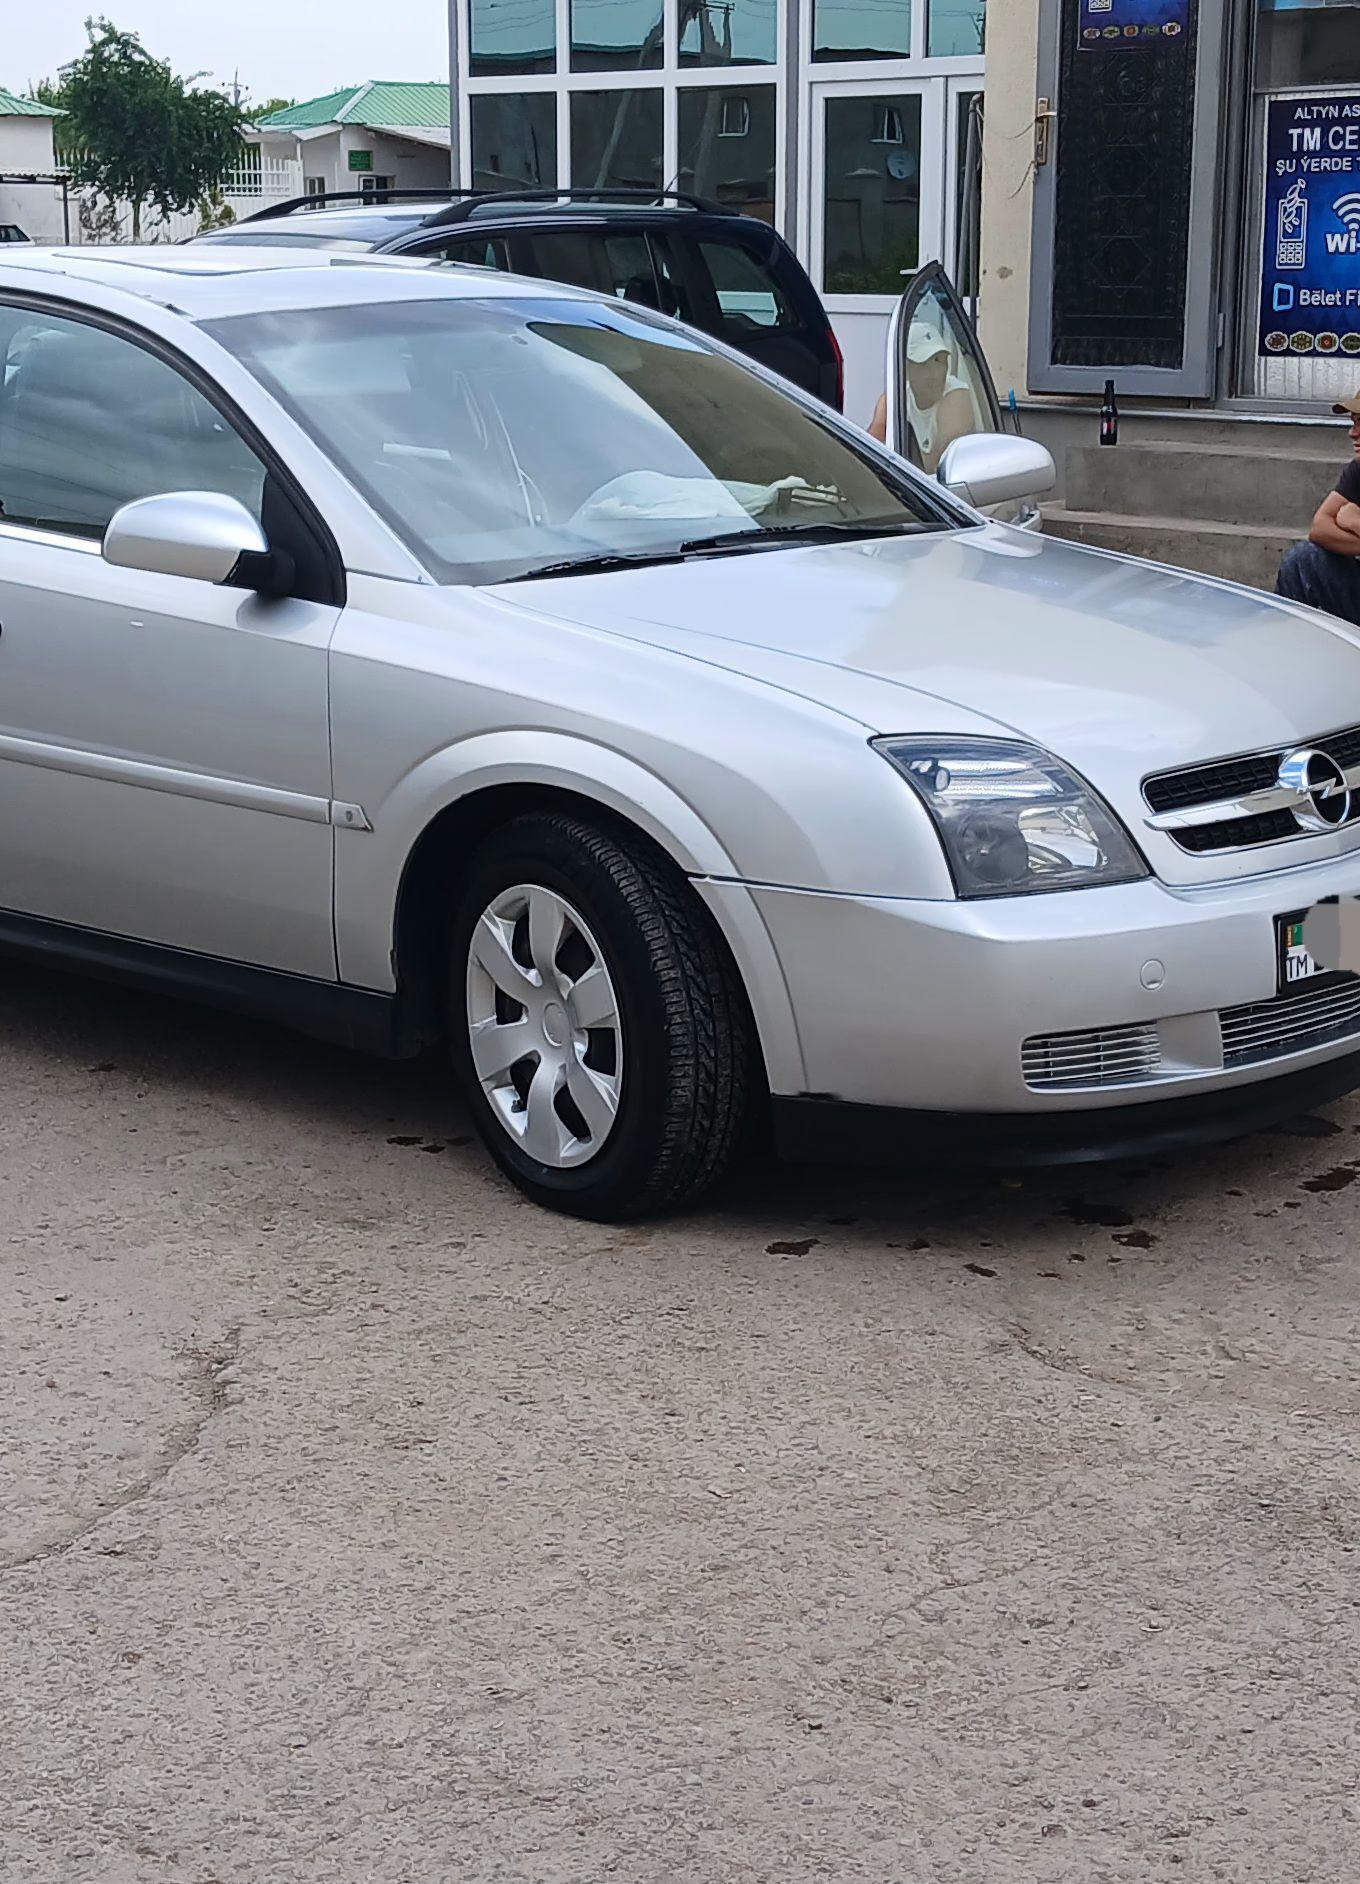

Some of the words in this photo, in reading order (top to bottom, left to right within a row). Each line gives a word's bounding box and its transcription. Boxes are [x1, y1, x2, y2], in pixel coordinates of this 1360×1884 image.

[1294, 105, 1339, 120] ALTYN
[1288, 127, 1321, 151] TM
[1276, 159, 1296, 176] ŞU
[1301, 156, 1353, 172] ÝERDE
[1285, 953, 1309, 979] TM
